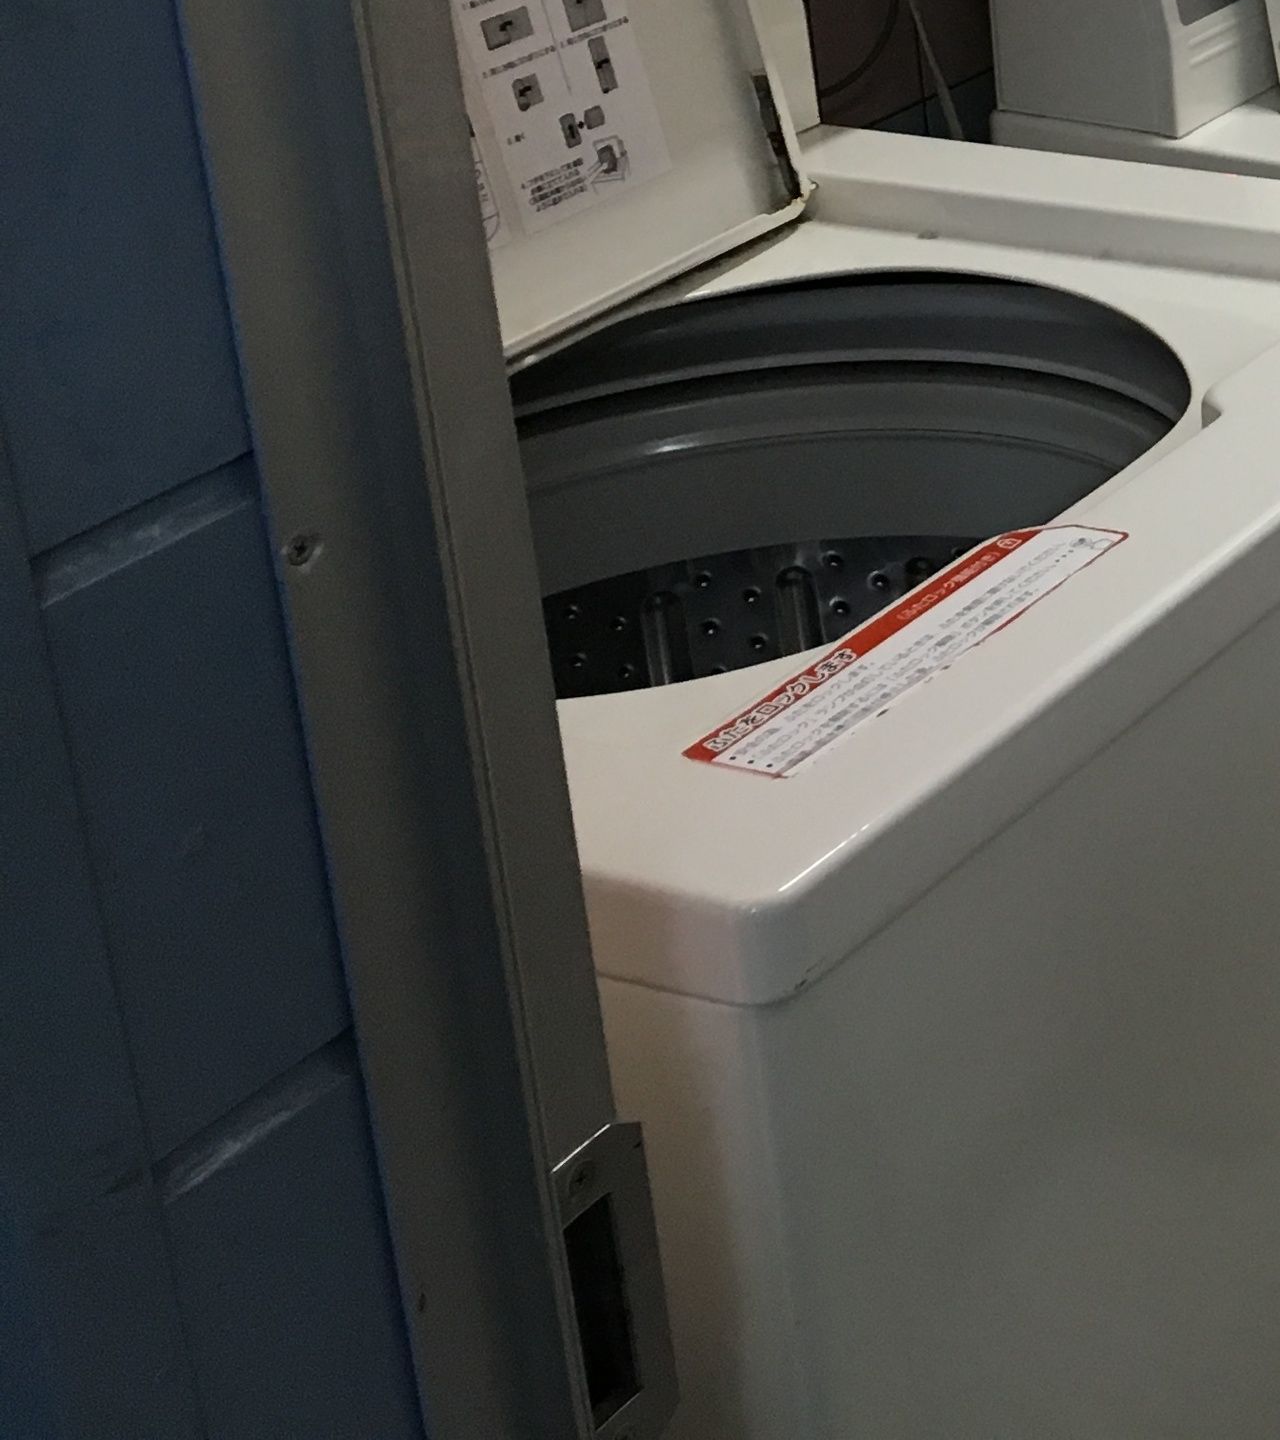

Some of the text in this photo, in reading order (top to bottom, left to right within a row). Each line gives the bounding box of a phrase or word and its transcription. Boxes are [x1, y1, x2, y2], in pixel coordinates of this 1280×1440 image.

[703, 648, 857, 752] ふたをロックします
